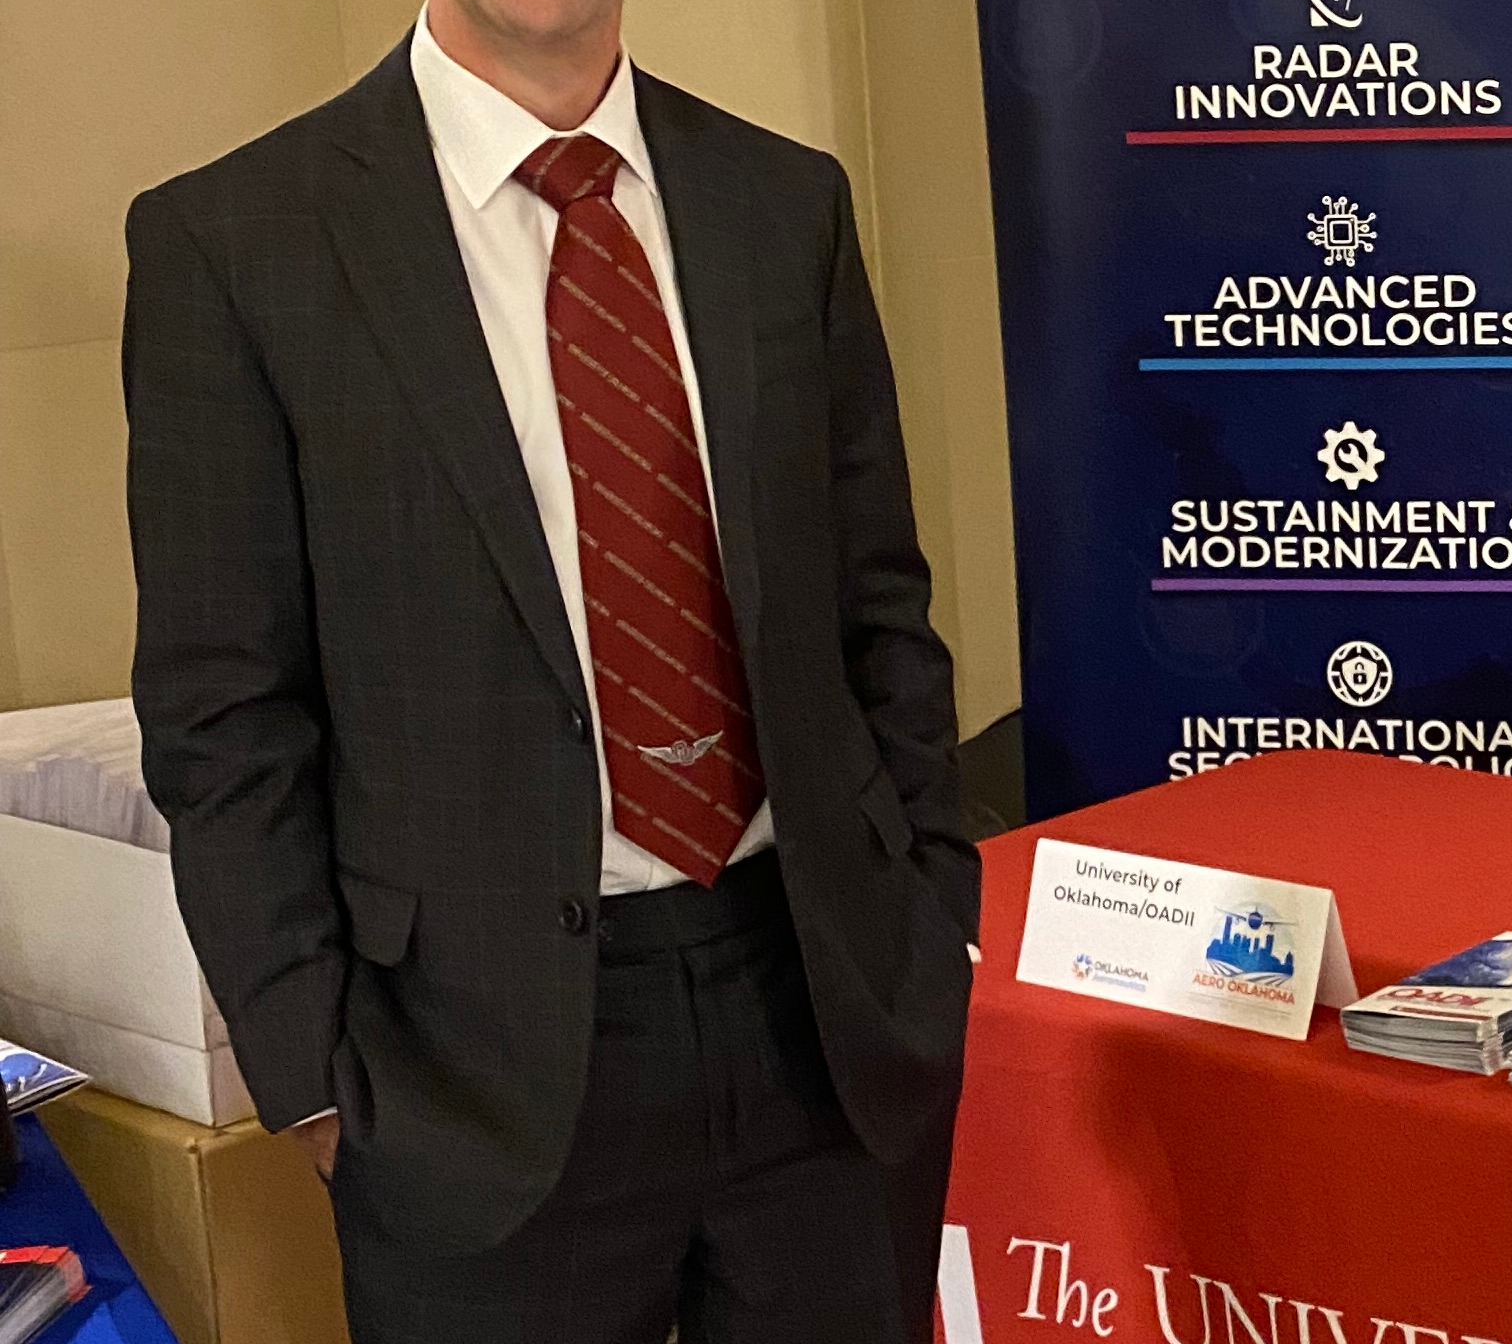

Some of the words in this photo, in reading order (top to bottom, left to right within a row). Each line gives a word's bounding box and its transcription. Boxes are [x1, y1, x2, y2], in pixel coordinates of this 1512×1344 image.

[1253, 42, 1420, 80] RADAR
[1174, 79, 1502, 120] INNOVATIONS
[1213, 274, 1478, 310] ADVANCED
[1170, 500, 1496, 534] SUSTAINMENT
[1075, 859, 1160, 894] University
[1164, 877, 1183, 895] of
[1053, 885, 1196, 927] Oklahoma/OADII
[1094, 960, 1149, 982] OKLAHOMA
[1192, 973, 1225, 991] AERO
[1227, 980, 1296, 1005] OKLAHOMA
[1006, 1235, 1119, 1338] The
